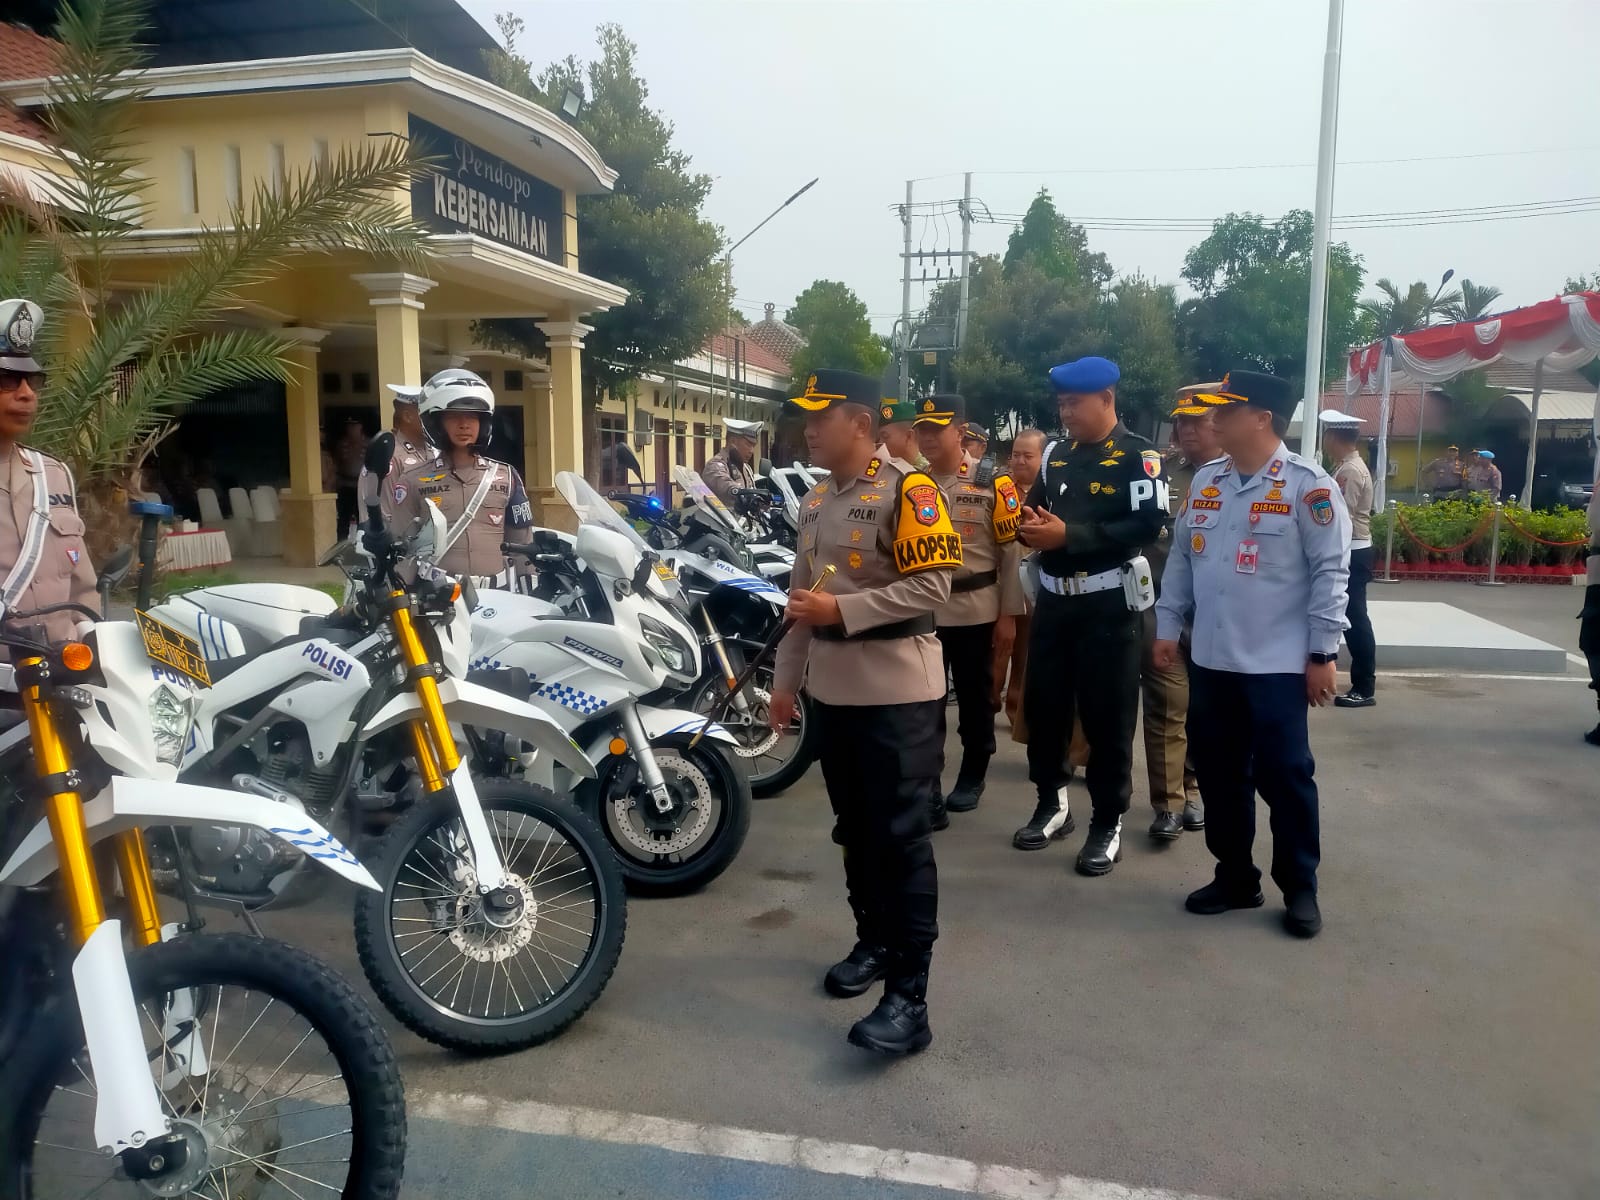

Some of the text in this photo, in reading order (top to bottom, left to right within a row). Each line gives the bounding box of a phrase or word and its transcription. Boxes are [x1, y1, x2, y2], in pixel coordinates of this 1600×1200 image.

[433, 173, 548, 257] KEBERSAMAAN
[956, 495, 983, 505] POLRI
[847, 508, 877, 521] POLRI
[1253, 503, 1288, 514] DISHUB
[301, 642, 353, 680] POLISI
